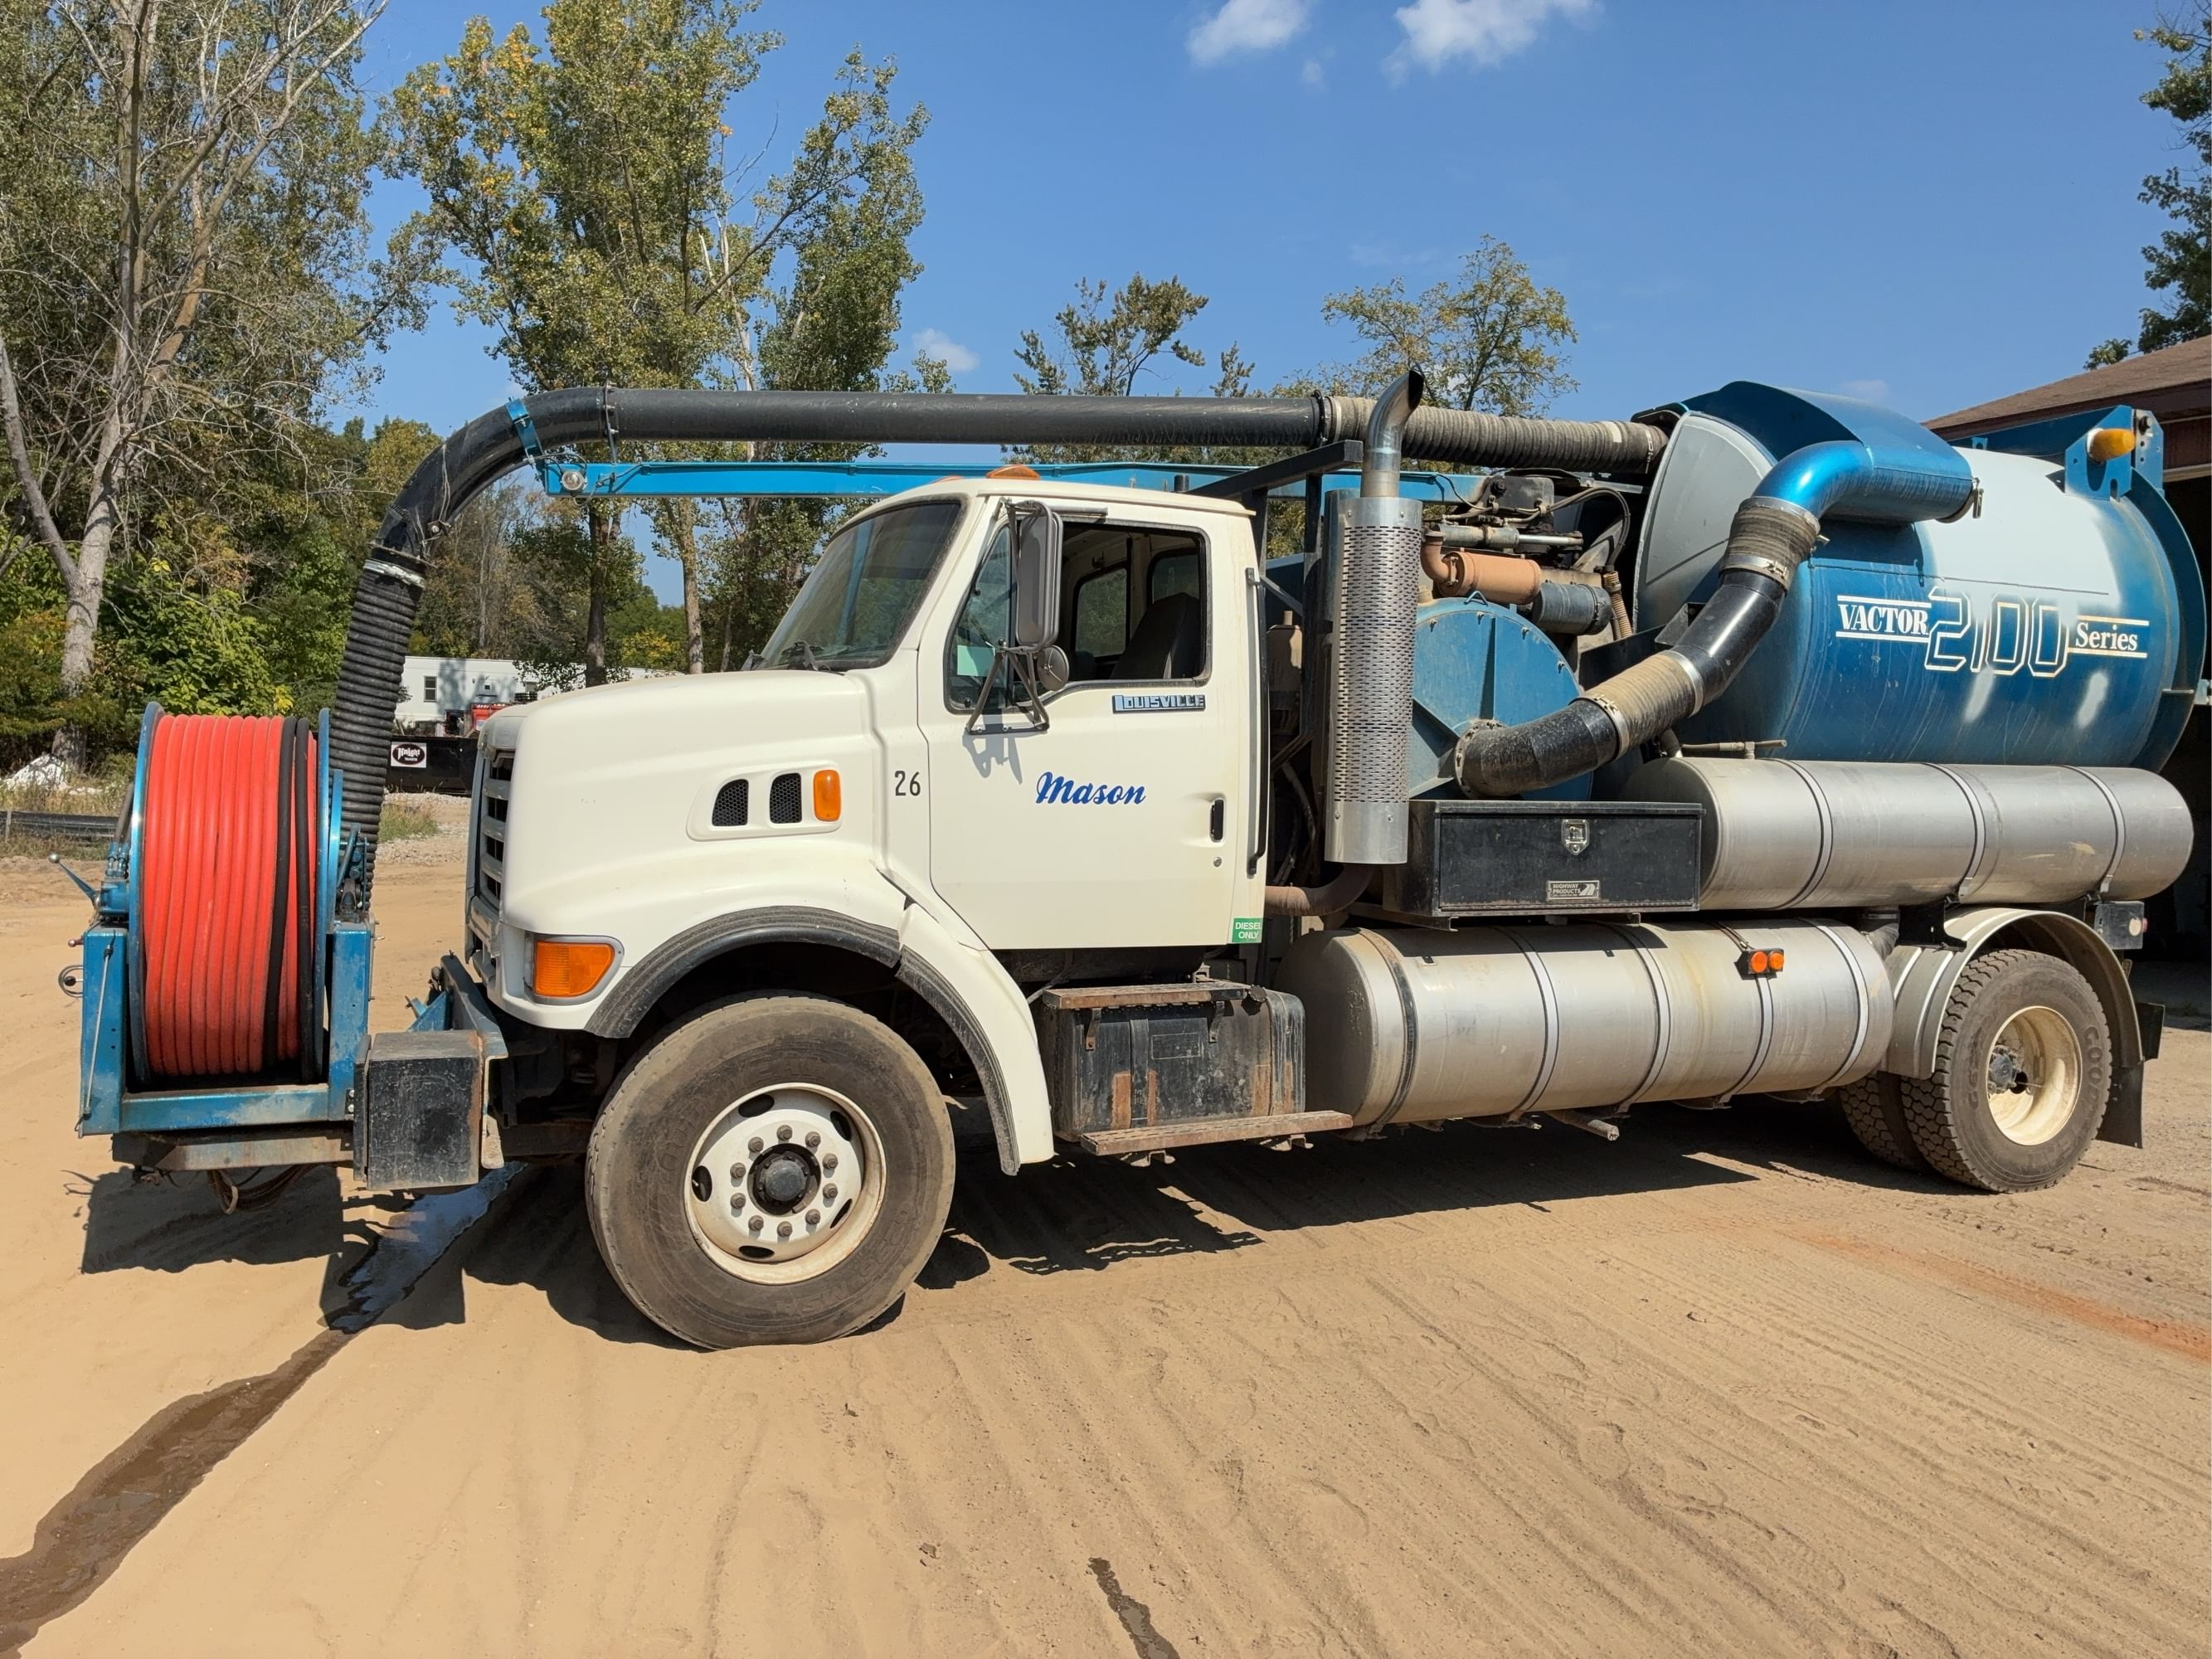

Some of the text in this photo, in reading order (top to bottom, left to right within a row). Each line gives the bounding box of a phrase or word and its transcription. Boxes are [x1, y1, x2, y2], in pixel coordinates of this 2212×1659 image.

[1838, 586, 2139, 678] VACTOR 2100 Series
[1114, 695, 1205, 711] LOUISVILLE
[396, 747, 421, 761] Knight
[894, 770, 921, 797] 26
[1036, 771, 1146, 805] Mason
[1235, 922, 1262, 930] DIESEL
[1238, 931, 1259, 939] ONLY
